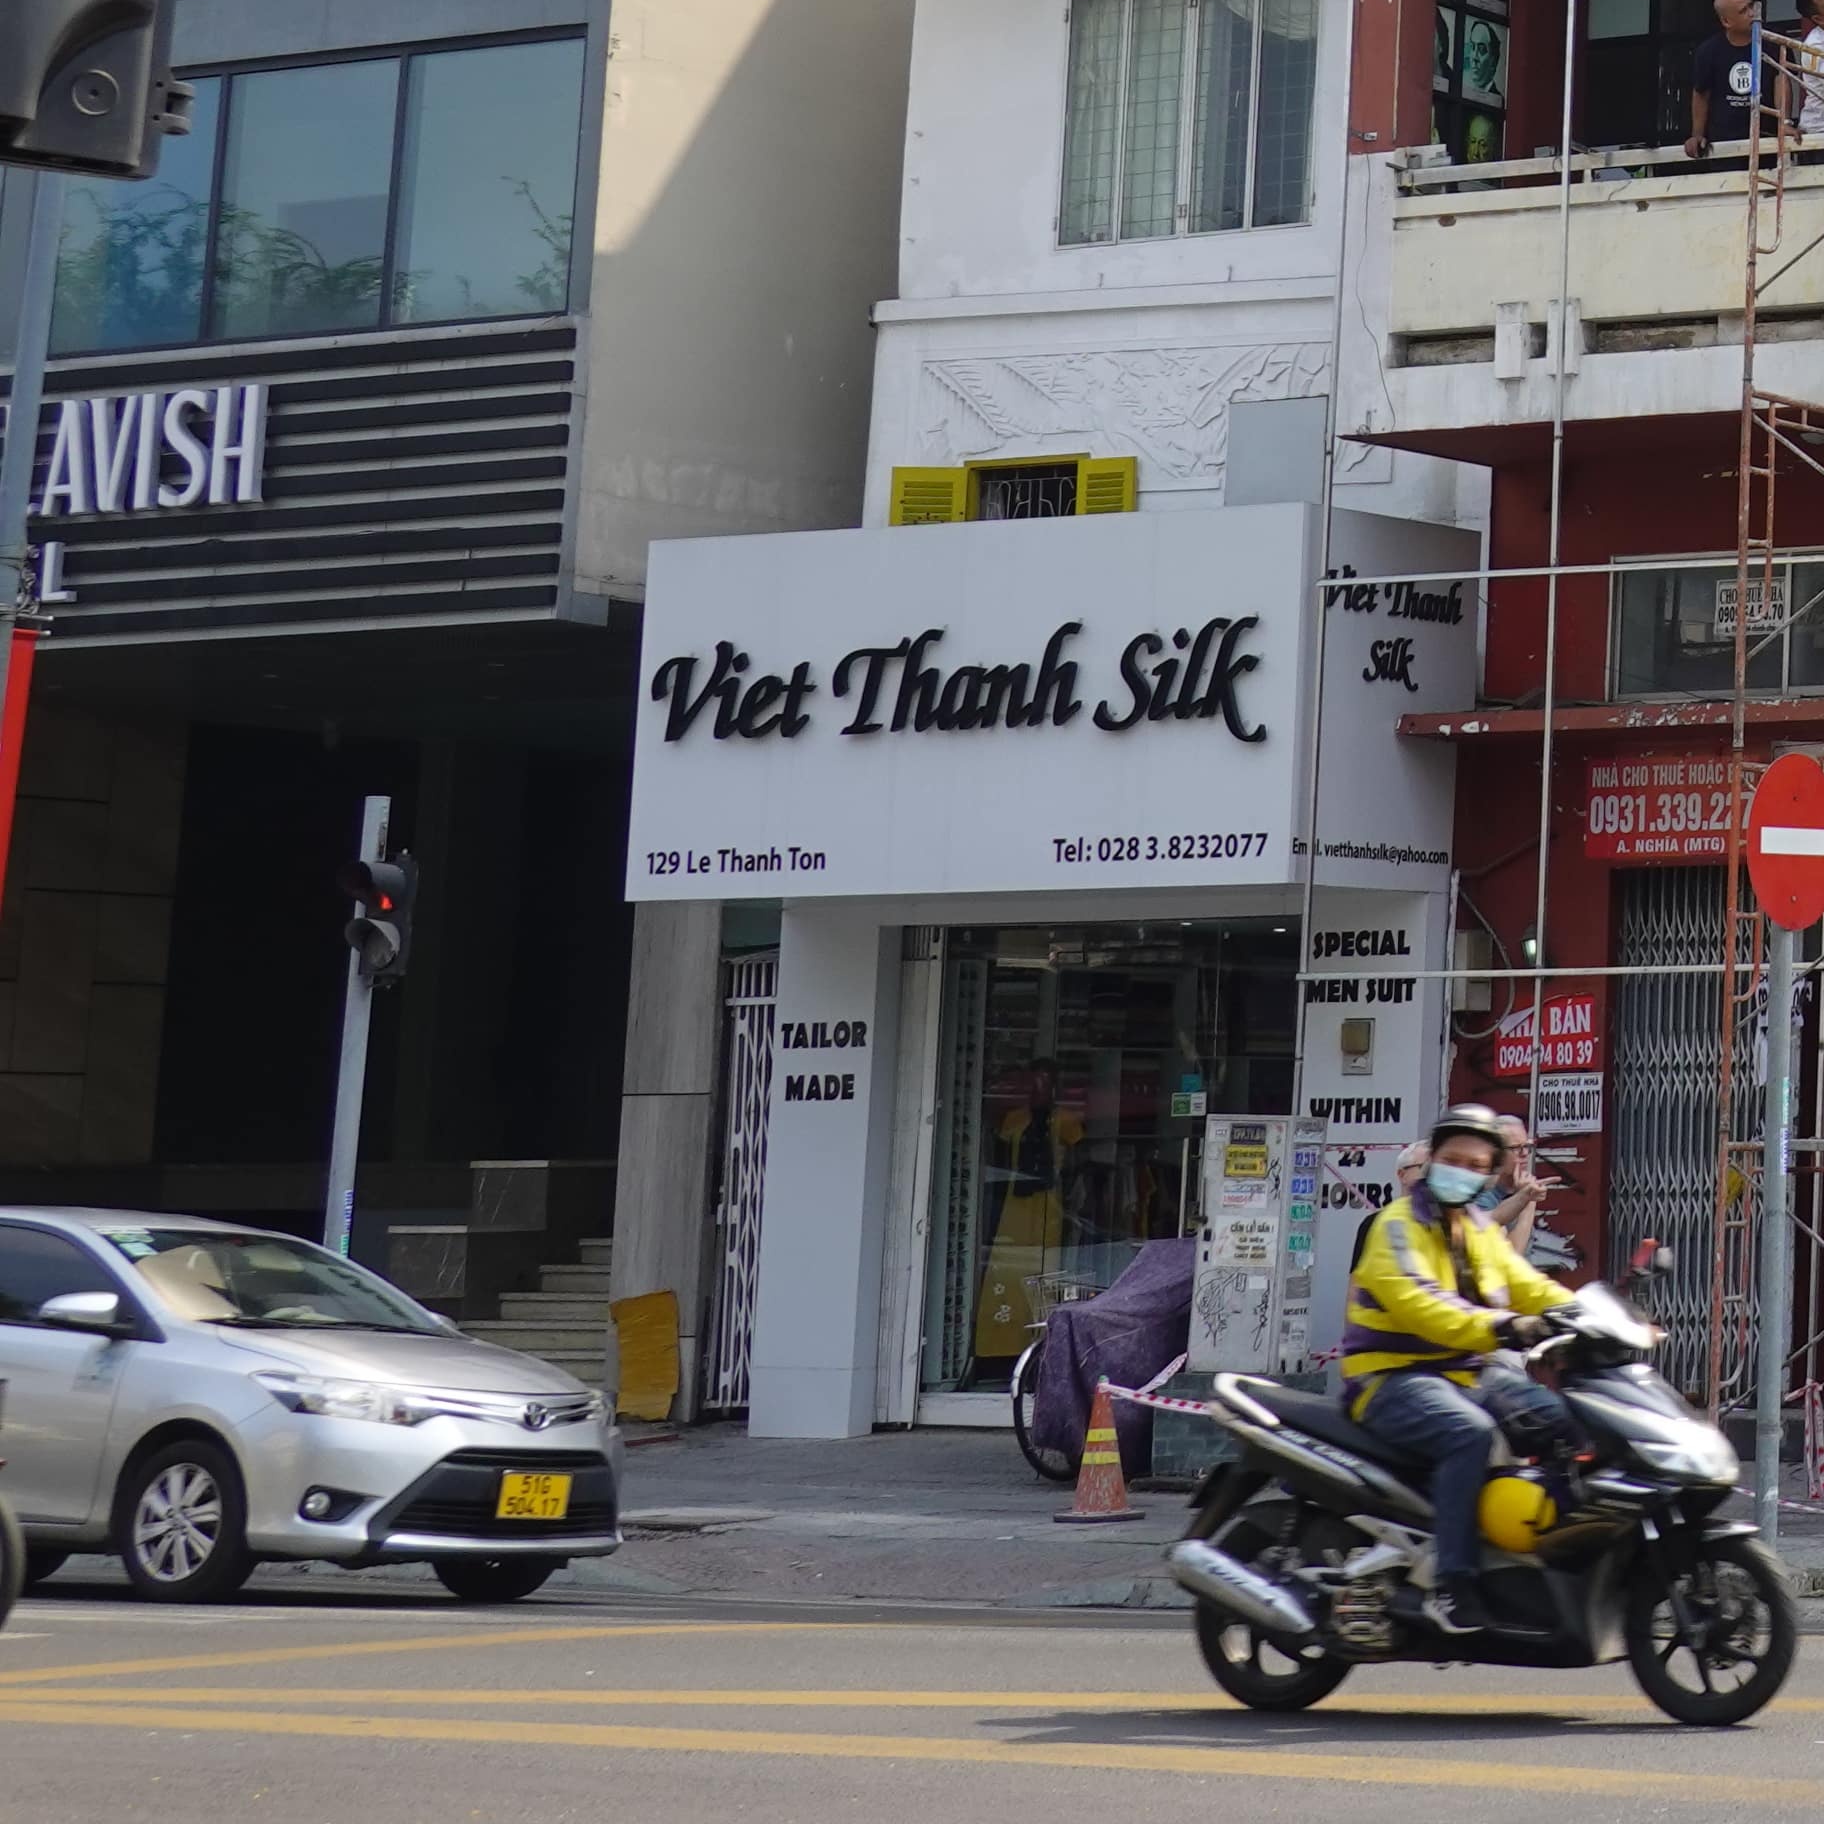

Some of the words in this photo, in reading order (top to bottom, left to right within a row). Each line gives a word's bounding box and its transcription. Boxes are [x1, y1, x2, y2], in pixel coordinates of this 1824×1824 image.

[27, 384, 269, 516] AVISH
[1327, 565, 1378, 611] Viet
[1385, 581, 1463, 625] Thanh
[651, 640, 814, 744] Viet
[832, 619, 1085, 735] Thanh
[1094, 612, 1267, 744] Silk
[1363, 637, 1418, 692] Silk
[646, 851, 682, 876] 129
[686, 849, 713, 875] Le
[717, 847, 784, 873] Thanh
[788, 845, 826, 872] Ton
[1053, 837, 1092, 863] Tel:
[1097, 835, 1140, 862] 028
[1146, 832, 1268, 861] 3.8232077
[1313, 930, 1410, 959] SPECIAL
[1306, 979, 1358, 1003] MEN
[1366, 978, 1416, 1003] SUIT
[781, 1022, 867, 1050] TAILOR
[785, 1072, 856, 1103] MADE
[1310, 1098, 1401, 1124] WITHIN
[1338, 1150, 1366, 1166] 24
